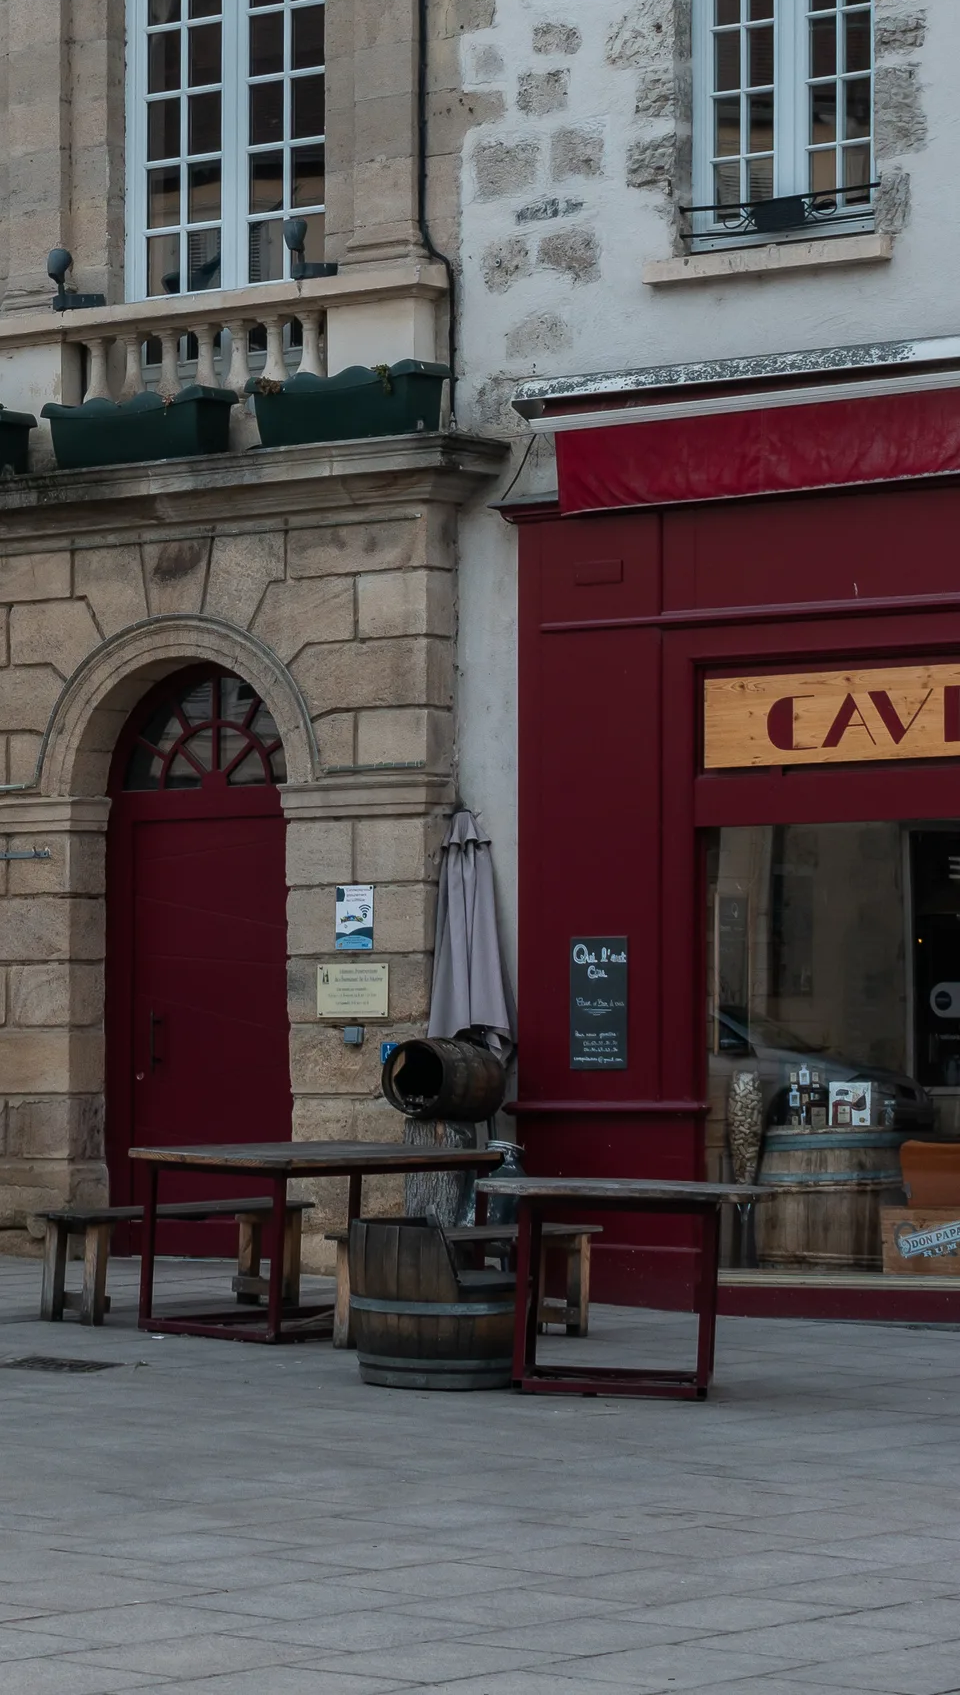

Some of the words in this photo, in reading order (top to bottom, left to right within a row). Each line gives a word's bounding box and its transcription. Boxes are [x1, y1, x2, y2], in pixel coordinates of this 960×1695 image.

[573, 943, 598, 964] Qui
[911, 1236, 933, 1248] DON
[923, 1242, 957, 1257] RUM
